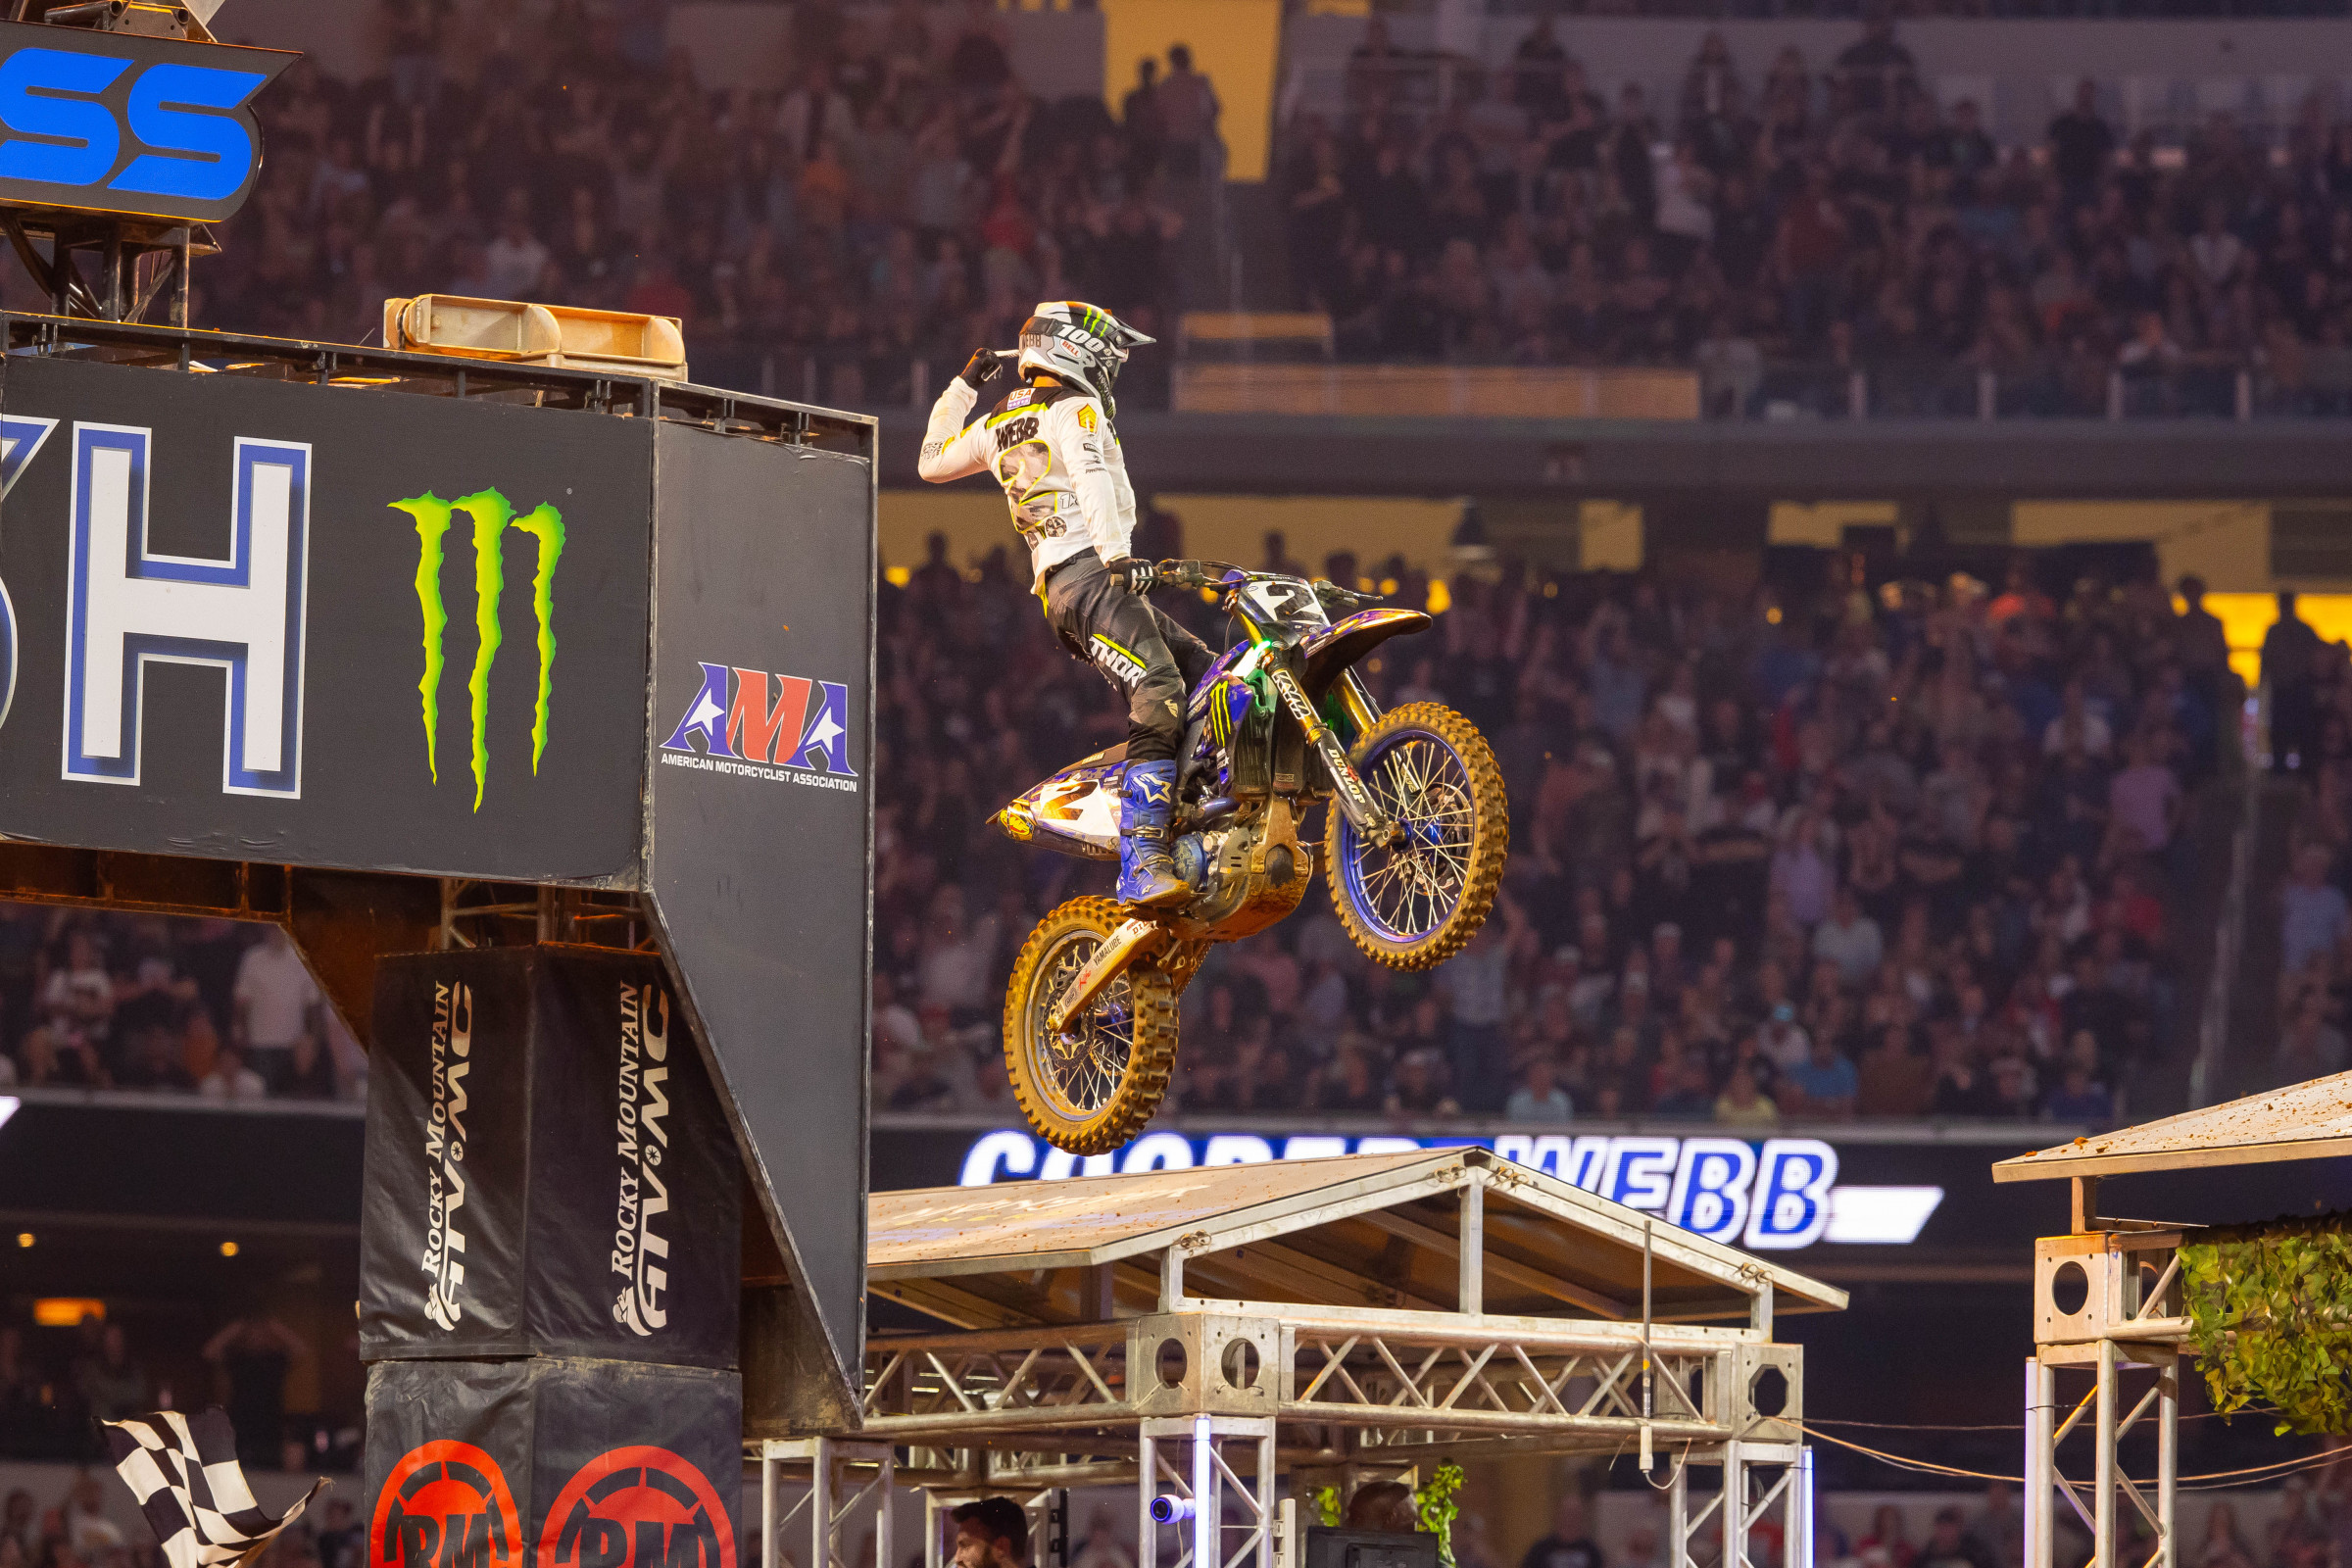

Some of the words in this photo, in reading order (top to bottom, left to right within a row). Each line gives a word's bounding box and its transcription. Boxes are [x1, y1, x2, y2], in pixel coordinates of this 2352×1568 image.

[1061, 340, 1080, 357] BELL
[1009, 388, 1032, 401] USA
[996, 416, 1040, 453] WEBB
[999, 438, 1058, 535] 2
[0, 414, 313, 801] H
[1265, 583, 1326, 624] 2
[1089, 636, 1148, 688] THOR
[659, 661, 859, 777] AMA
[661, 753, 714, 772] AMERICAN
[715, 760, 792, 783] MOTORCYCLIST
[792, 772, 858, 793] ASSOCIATION
[1039, 781, 1099, 820] 2
[1327, 748, 1366, 804] DUNLOP
[1093, 935, 1122, 966] YAMALUBE
[425, 981, 451, 1164] MOUNTAIN
[617, 981, 640, 1165] MOUNTAIN
[1494, 1135, 1840, 1249] WEBB
[421, 1166, 444, 1277] ROCKY
[612, 1166, 639, 1281] ROCKY
